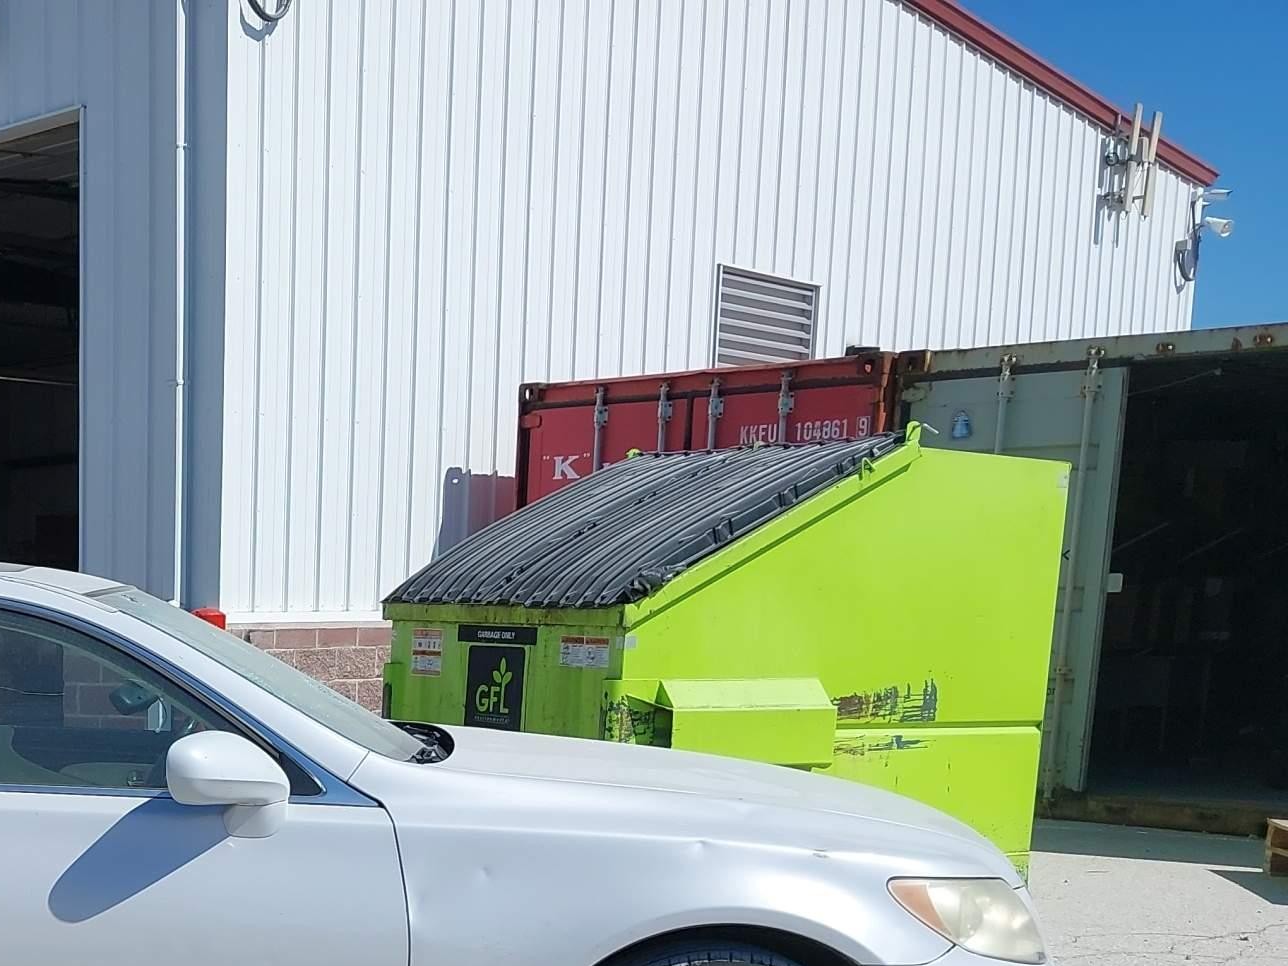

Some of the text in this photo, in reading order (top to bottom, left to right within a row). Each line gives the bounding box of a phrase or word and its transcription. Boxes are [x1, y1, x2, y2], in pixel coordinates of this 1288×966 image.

[795, 418, 848, 441] 104861
[857, 417, 869, 437] 9
[475, 684, 509, 713] GFL
